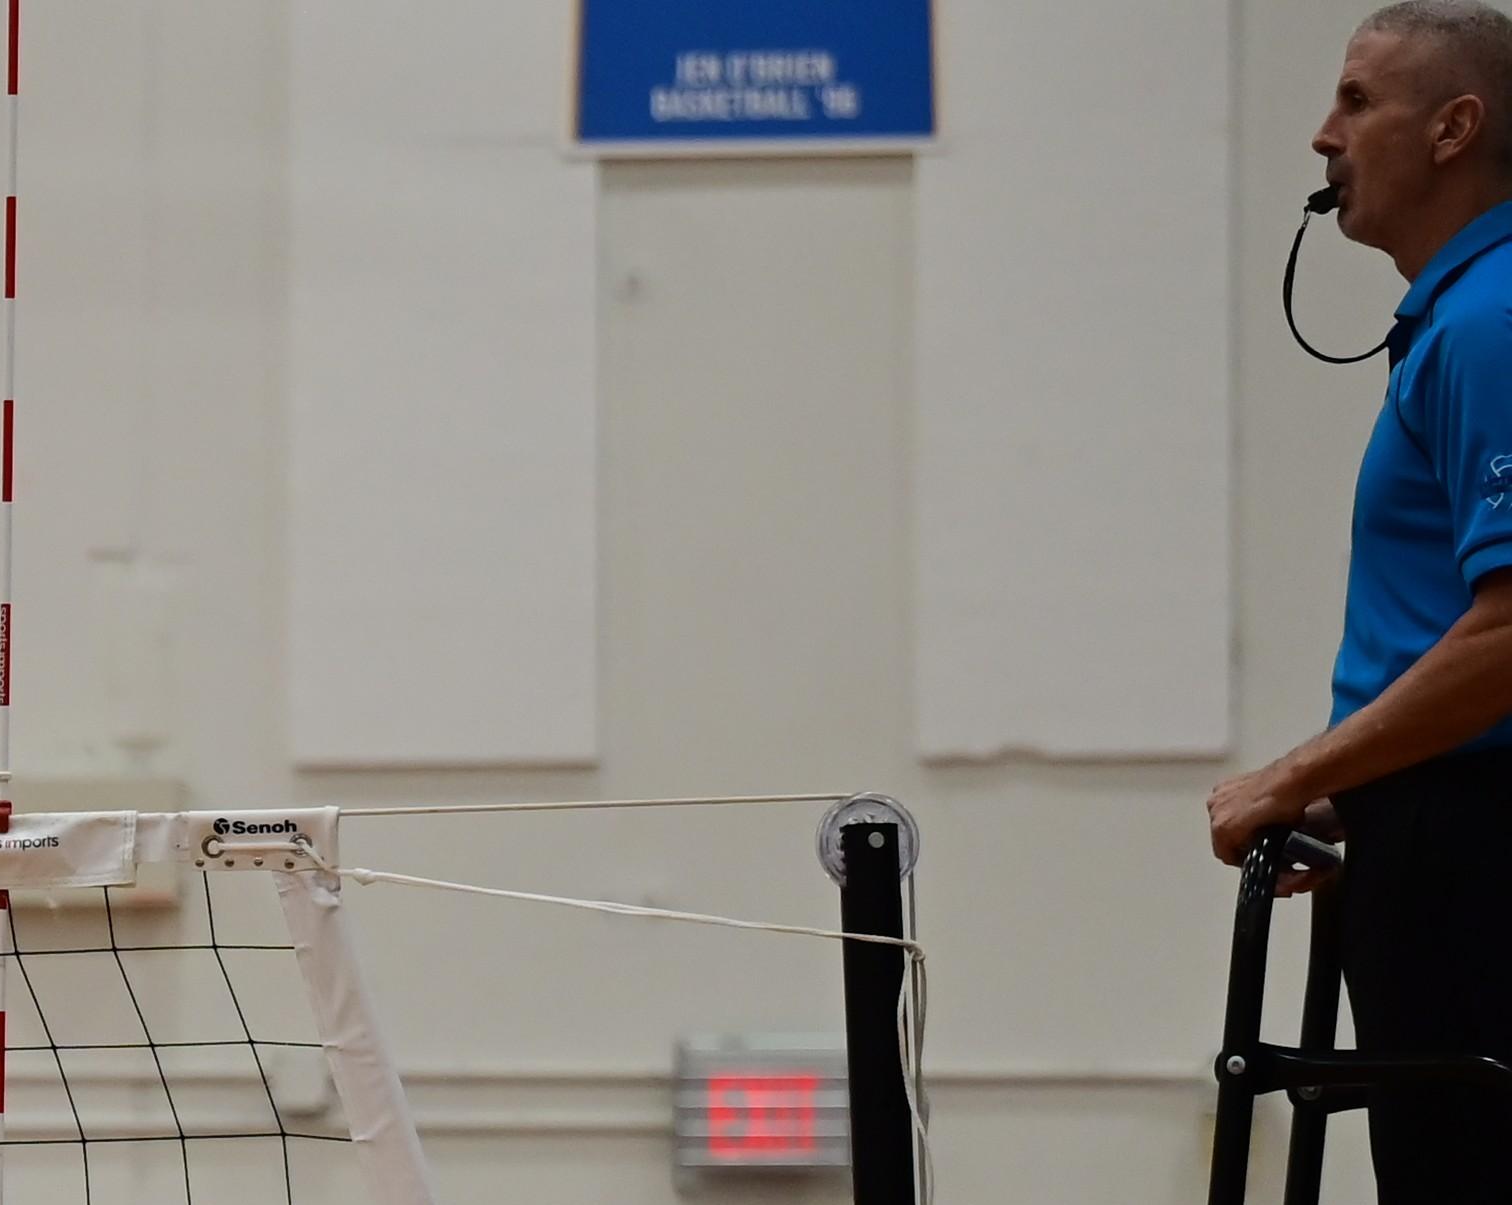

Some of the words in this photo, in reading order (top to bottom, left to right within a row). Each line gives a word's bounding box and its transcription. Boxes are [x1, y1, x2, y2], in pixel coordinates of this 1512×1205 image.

[232, 819, 297, 835] Senoh
[4, 834, 59, 850] imports
[708, 1075, 818, 1157] EXIT
